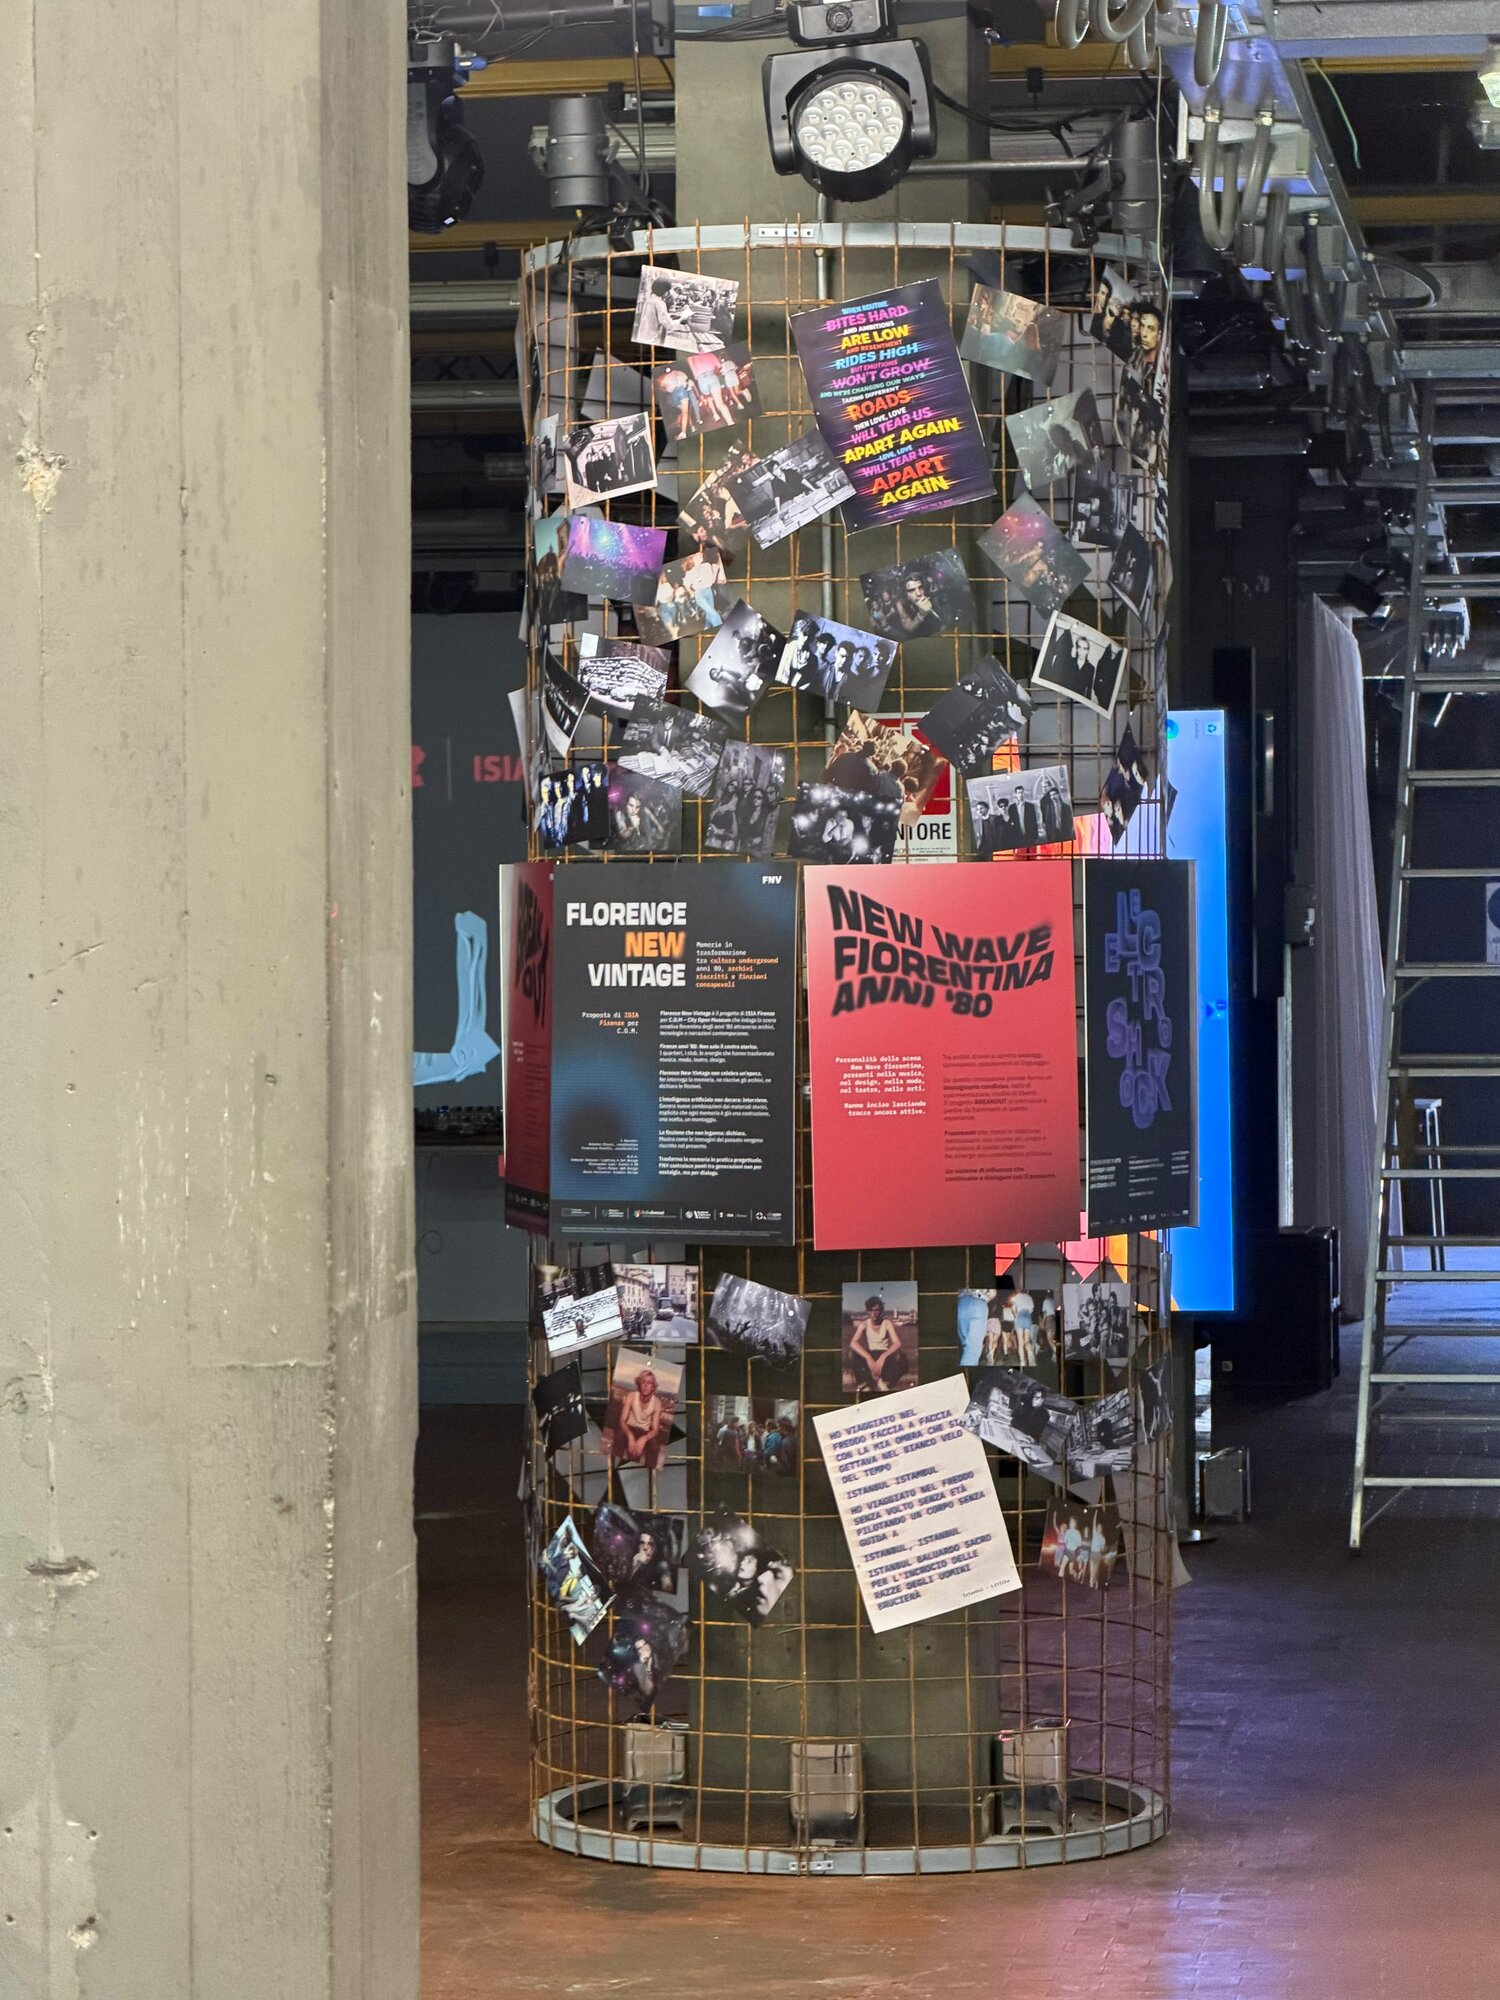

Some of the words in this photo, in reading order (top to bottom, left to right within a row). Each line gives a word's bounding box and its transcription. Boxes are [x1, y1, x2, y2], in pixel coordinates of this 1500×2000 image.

[825, 313, 866, 331] BITES
[868, 305, 909, 322] HARD
[841, 305, 861, 315] WHEN
[862, 301, 888, 311] ROUTINE
[841, 332, 871, 350] ARE
[873, 324, 909, 342] LOW
[843, 327, 858, 335] AND
[858, 321, 895, 332] AMBITIONS
[835, 352, 876, 369] RIDES
[879, 342, 919, 360] HIGH
[846, 346, 860, 355] AND
[860, 339, 902, 351] RESENTMENT
[832, 370, 877, 389] WON'T
[880, 357, 931, 379] GROW
[850, 365, 863, 374] BUT
[864, 359, 898, 371] EMOTIONS
[841, 394, 864, 404] TAKING
[865, 386, 900, 399] DIFFERENT
[851, 382, 885, 394] CHANGING
[886, 379, 901, 387] OUR
[902, 372, 926, 383] WAYS
[847, 389, 912, 420] ROADS
[851, 428, 878, 444] WILL
[879, 413, 911, 434] TEAR
[913, 407, 932, 421] US
[854, 422, 869, 431] THEN
[870, 414, 888, 427] LOVE,
[888, 407, 907, 418] LOVE
[844, 434, 896, 464] APART
[900, 418, 960, 445] AGAIN
[880, 451, 896, 461] LOVE,
[897, 445, 913, 455] LOVE
[861, 462, 889, 477] WILL
[889, 451, 917, 468] TEAR
[918, 445, 935, 457] US
[872, 456, 945, 494] APART
[882, 476, 949, 506] AGAIN
[762, 875, 782, 884] FNV
[566, 902, 687, 926] FLORENCE
[826, 884, 923, 949] NEW
[930, 922, 1053, 963] WAVE
[625, 931, 686, 959] NEW
[588, 963, 687, 987] VINTAGE
[739, 957, 779, 965] underground
[834, 936, 1055, 991] FIORENTINA
[831, 975, 935, 1018] ANNI
[843, 1071, 874, 1079] presenti
[892, 1100, 927, 1108] lasciando
[829, 1431, 841, 1440] HO
[845, 1415, 896, 1436] VIAGGIATO
[900, 1408, 917, 1419] NEL
[832, 1436, 866, 1450] FREDDO
[871, 1425, 904, 1439] FACCIA
[908, 1421, 914, 1429] A
[919, 1410, 952, 1425] FACCIA
[836, 1452, 853, 1462] CON
[858, 1446, 869, 1455] LA
[873, 1440, 891, 1452] MIA
[895, 1431, 924, 1445] OMBRA
[927, 1424, 945, 1435] CHE
[838, 1456, 879, 1473] GETTAVA
[881, 1450, 900, 1460] NEL
[903, 1438, 937, 1454] BIANCO
[941, 1430, 963, 1442] VELO
[842, 1474, 859, 1484] DEL
[864, 1462, 892, 1477] TEMPO
[850, 1506, 862, 1515] HO
[866, 1489, 916, 1510] VIAGGIATO
[920, 1483, 938, 1493] NEL
[942, 1471, 975, 1487] FREDDO
[853, 1511, 882, 1525] SENZA
[886, 1501, 914, 1516] VOLTO
[918, 1492, 947, 1507] SENZA
[950, 1483, 967, 1497] ETÀ
[856, 1515, 906, 1536] PILOTANDO
[910, 1511, 923, 1521] UN
[926, 1501, 954, 1515] CORPO
[958, 1491, 986, 1505] SENZA
[859, 1533, 888, 1547] GUIDA
[868, 1560, 912, 1578] ISTANBUL
[916, 1544, 960, 1563] BALUARDO
[964, 1533, 992, 1548] SACRO
[871, 1578, 889, 1589] PER
[951, 1549, 979, 1564] DELLE
[874, 1586, 902, 1599] RAZZE
[906, 1576, 935, 1590] DEGLI
[939, 1563, 972, 1580] UOMINI
[877, 1590, 921, 1610] BRUCIERÀ
